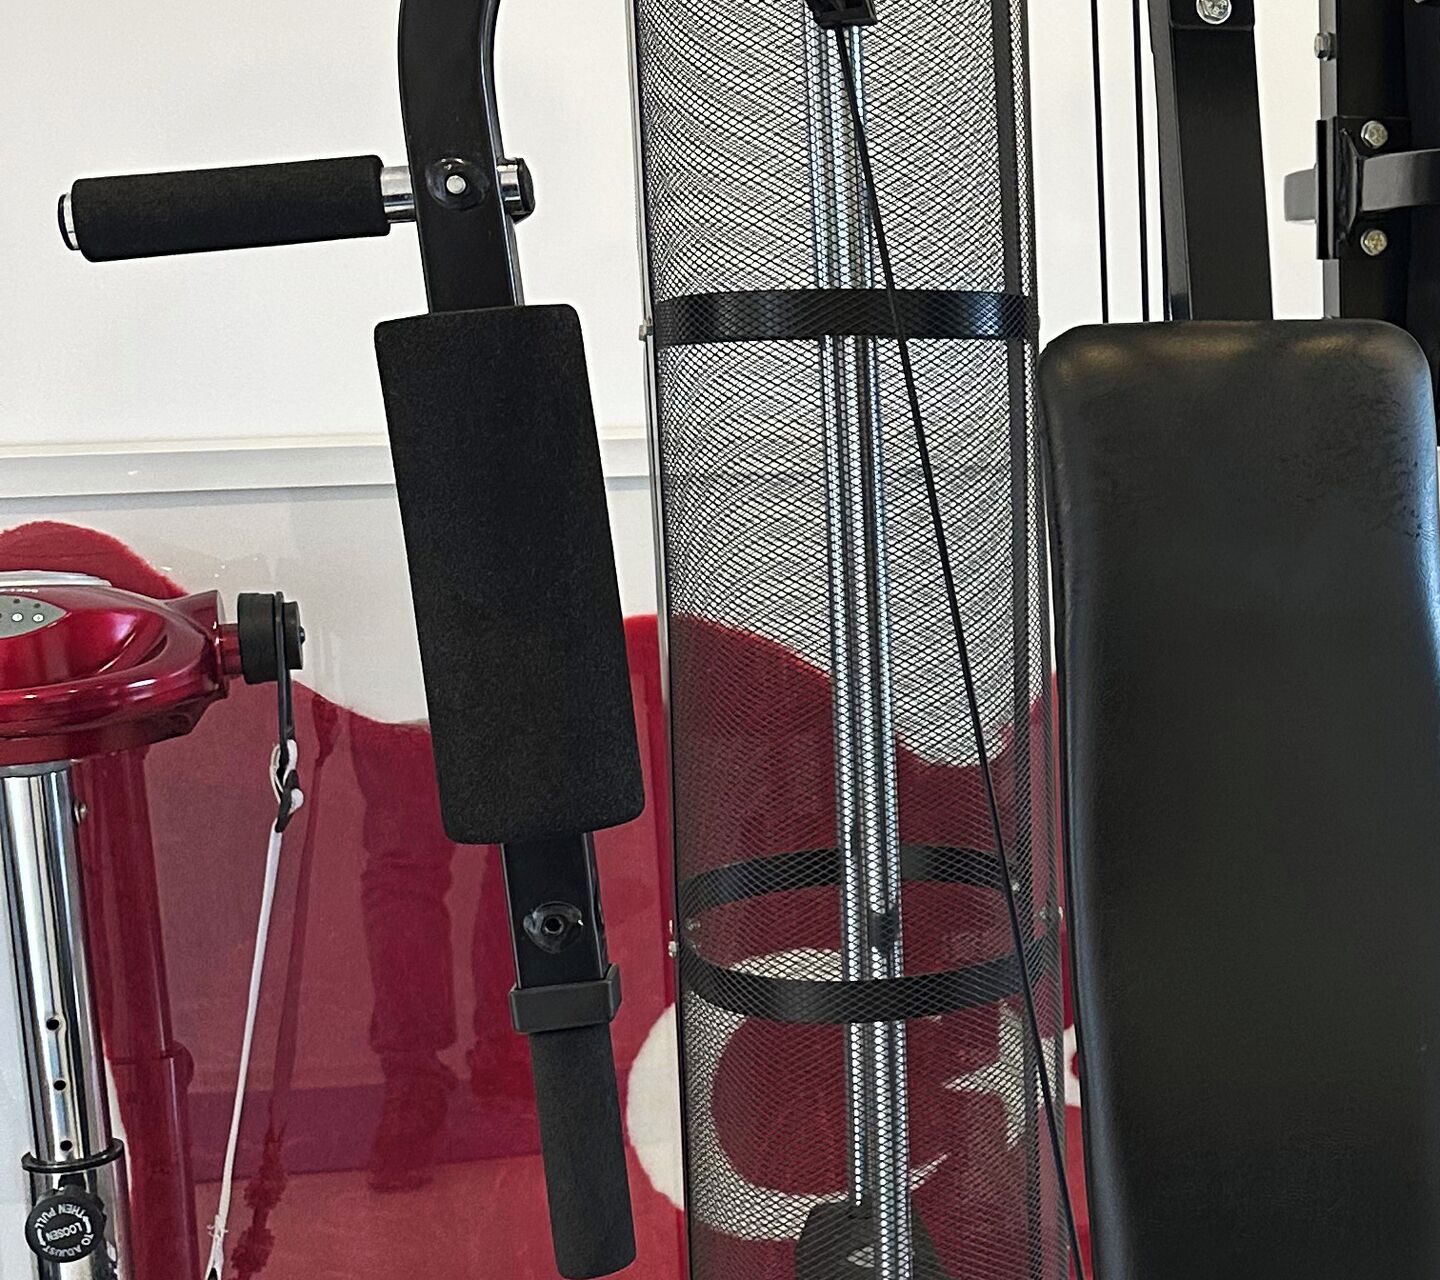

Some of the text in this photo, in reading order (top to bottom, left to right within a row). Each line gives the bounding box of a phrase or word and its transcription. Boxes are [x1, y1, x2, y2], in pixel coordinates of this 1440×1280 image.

[34, 1203, 86, 1229] THEN PULL
[45, 1221, 83, 1242] LOOSEN
[42, 1233, 94, 1257] TO ADJUST
